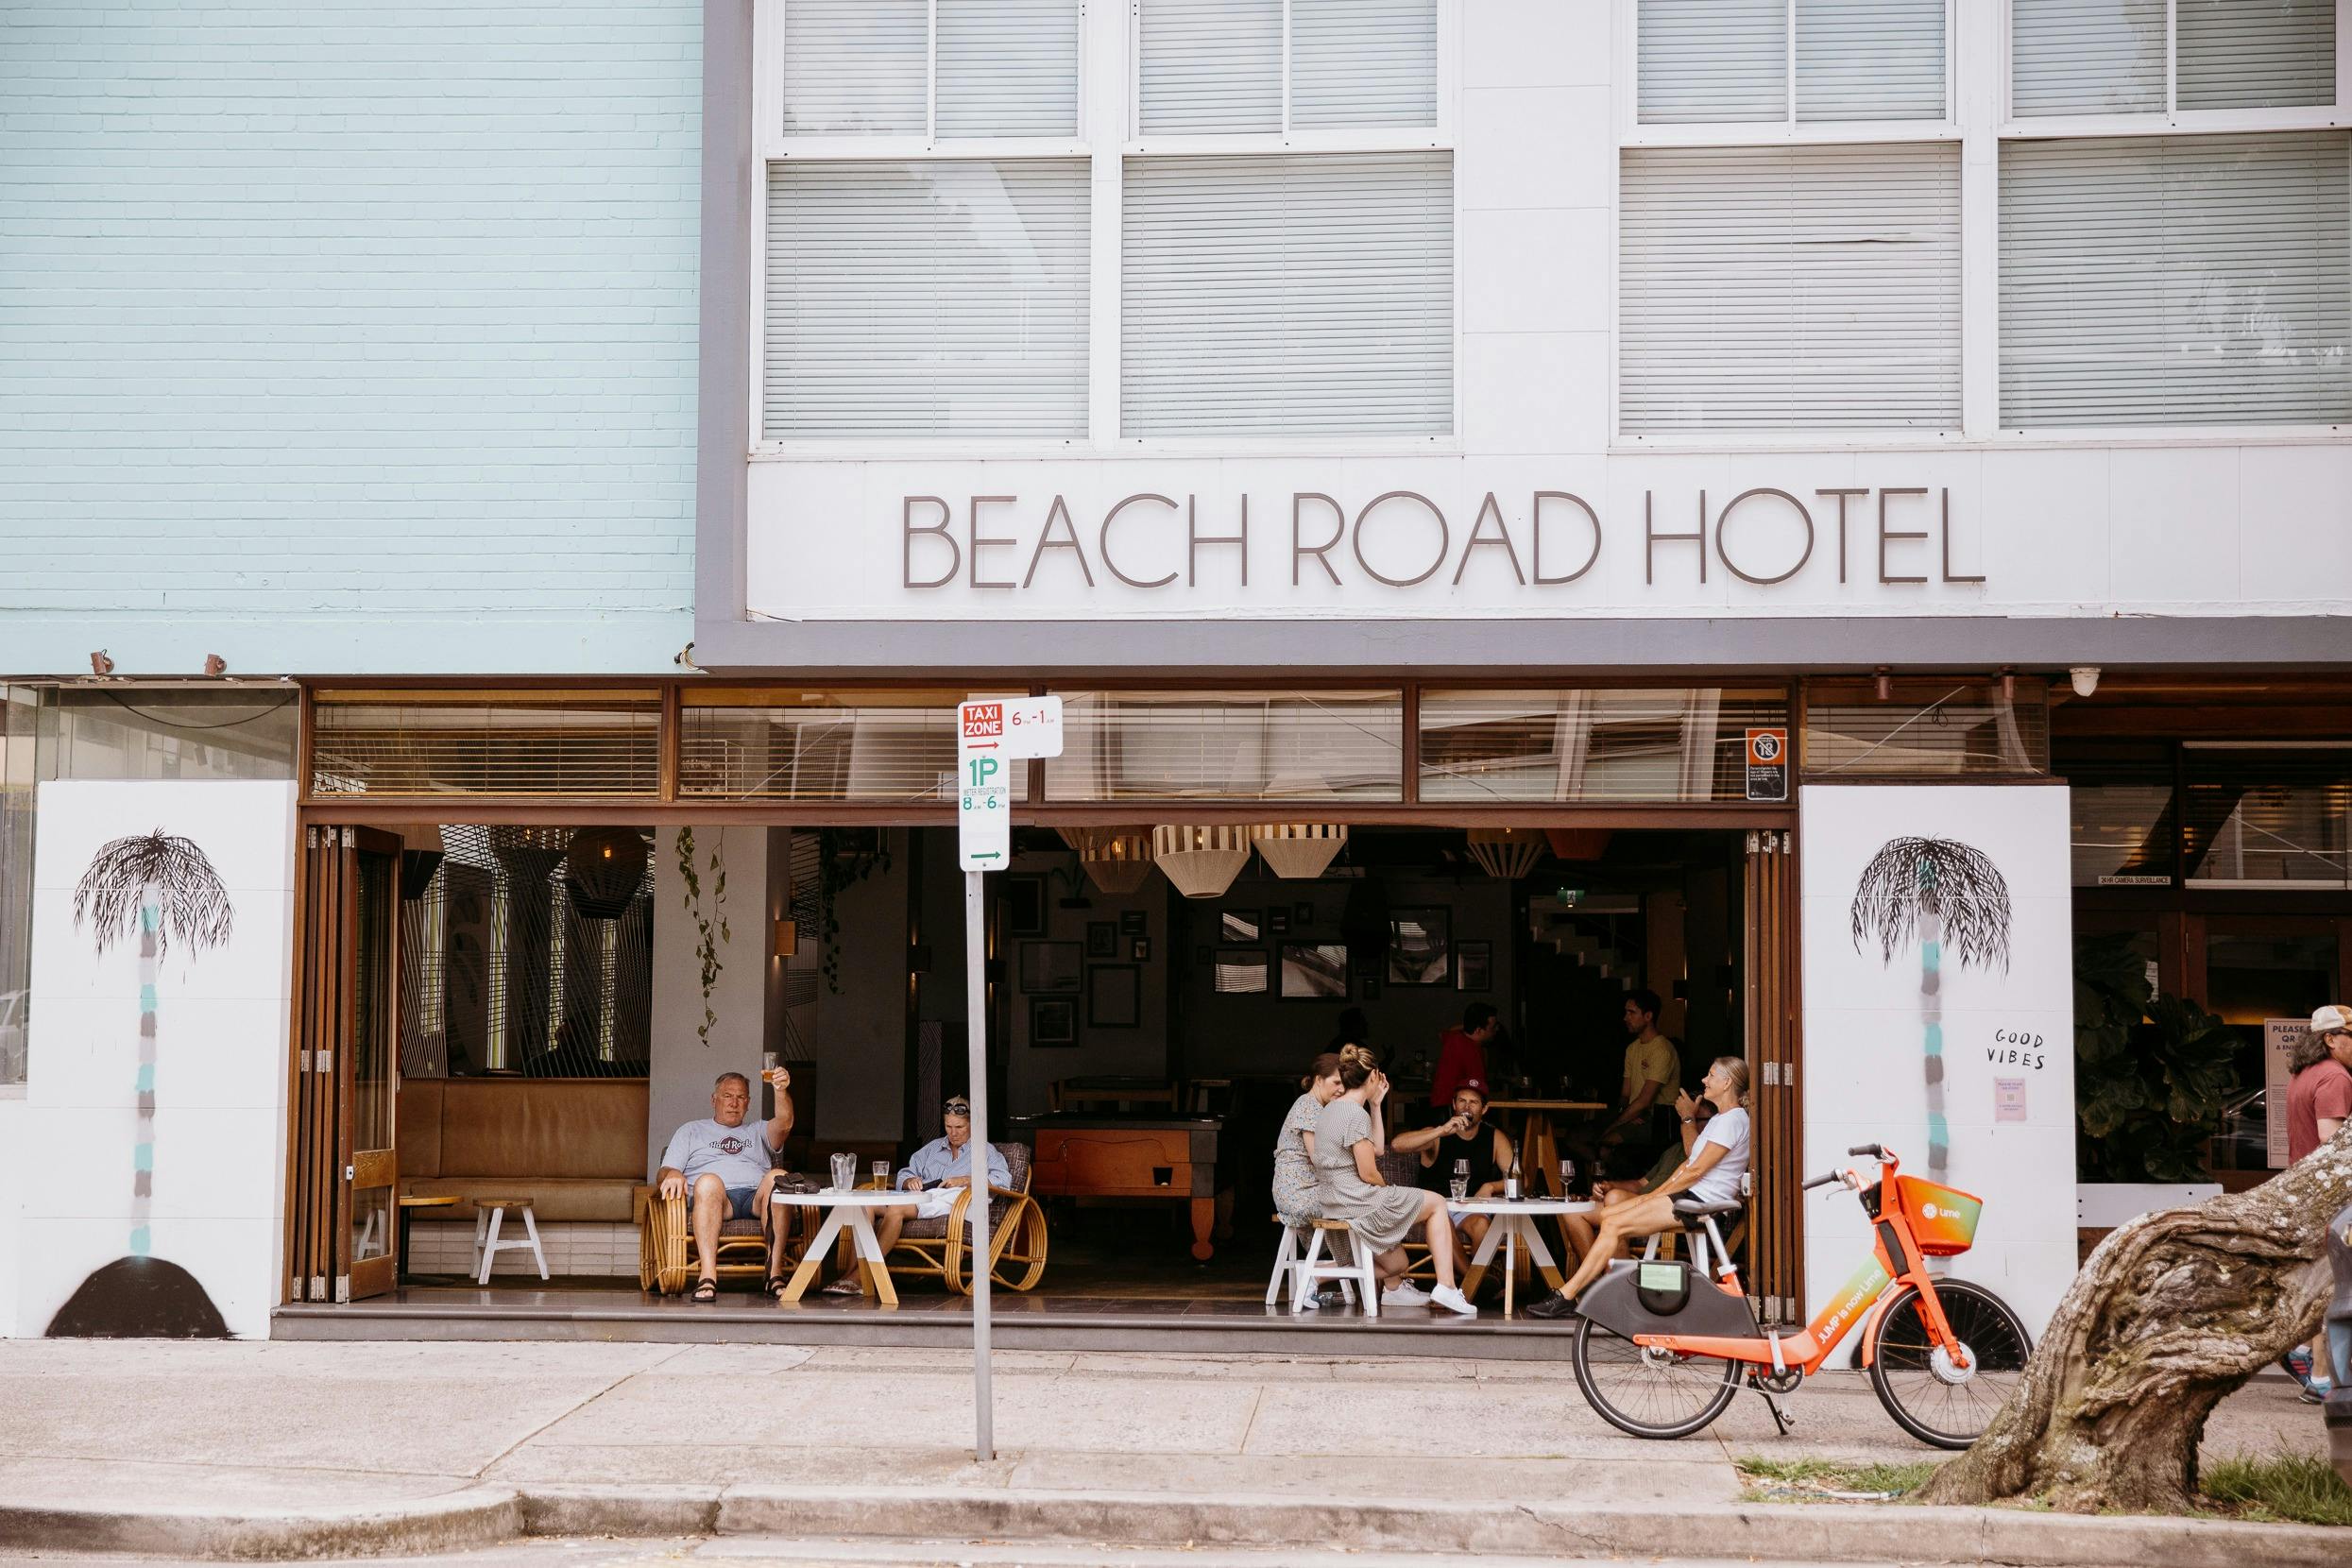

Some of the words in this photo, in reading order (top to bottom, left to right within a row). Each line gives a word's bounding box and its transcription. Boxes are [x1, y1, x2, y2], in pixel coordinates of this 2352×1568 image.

[903, 493, 1248, 589] BEACH
[1293, 490, 1602, 588] ROAD
[1645, 486, 1986, 585] HOTEL
[966, 707, 998, 721] TAXI
[964, 722, 1002, 736] ZONE
[969, 758, 998, 787] 1P
[1995, 1029, 2043, 1048] GOOD
[2281, 1034, 2295, 1043] QR
[1986, 1048, 2045, 1070] VIBES
[709, 1139, 731, 1150] Hard
[731, 1138, 754, 1150] Rock
[1938, 1207, 1961, 1219] Lime
[1817, 1315, 1841, 1345] JUMP
[1845, 1288, 1865, 1312] now
[1859, 1269, 1883, 1293] Lime
